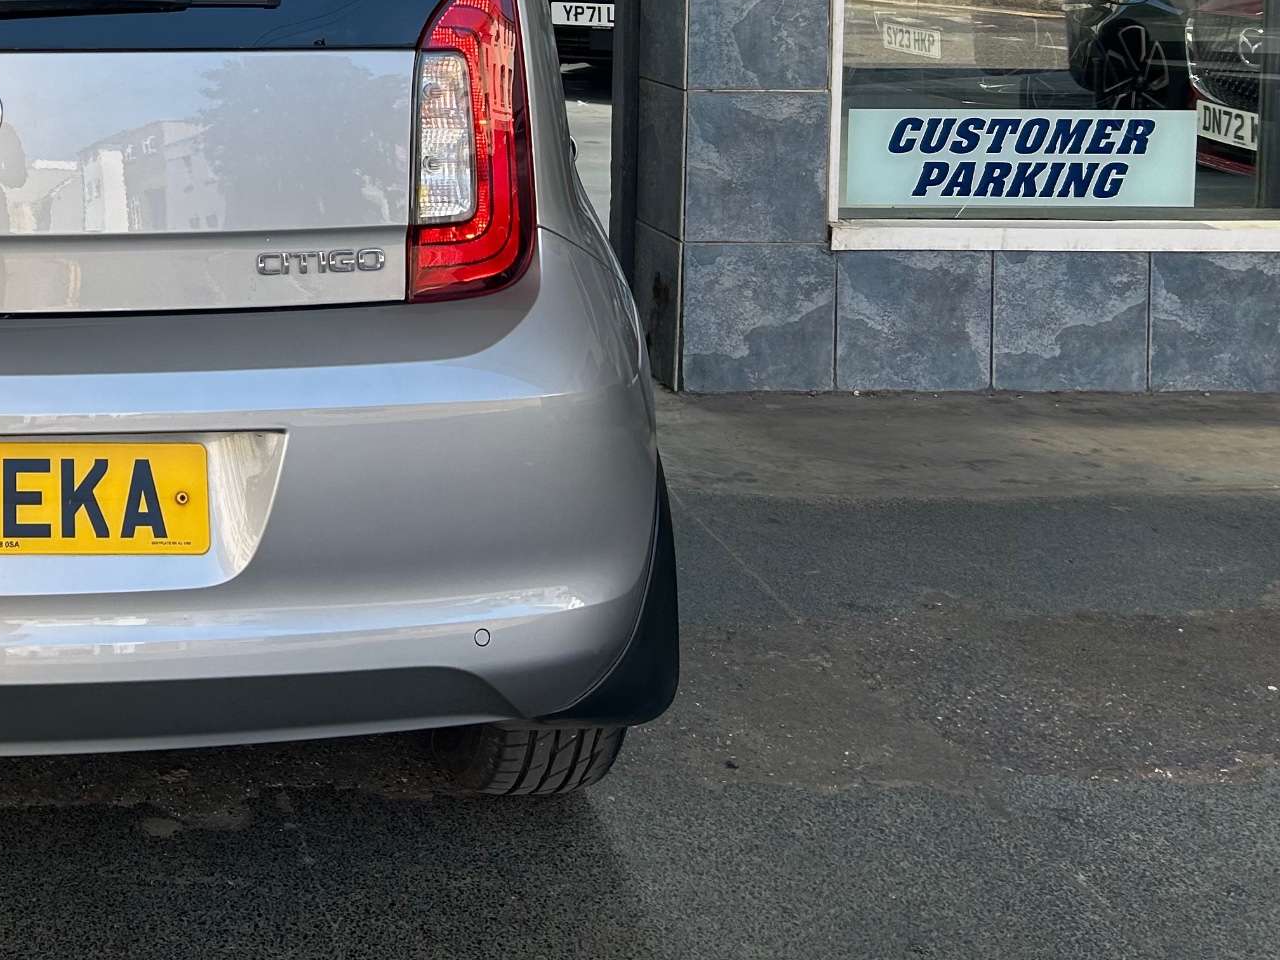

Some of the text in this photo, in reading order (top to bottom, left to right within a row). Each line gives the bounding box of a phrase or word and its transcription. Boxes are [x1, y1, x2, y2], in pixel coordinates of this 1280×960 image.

[562, 4, 602, 23] YP71
[888, 117, 1156, 155] CUSTOMER
[1202, 105, 1245, 141] DN72
[911, 161, 1129, 199] PARKING
[256, 247, 385, 276] CITIGO
[2, 458, 169, 539] EKA
